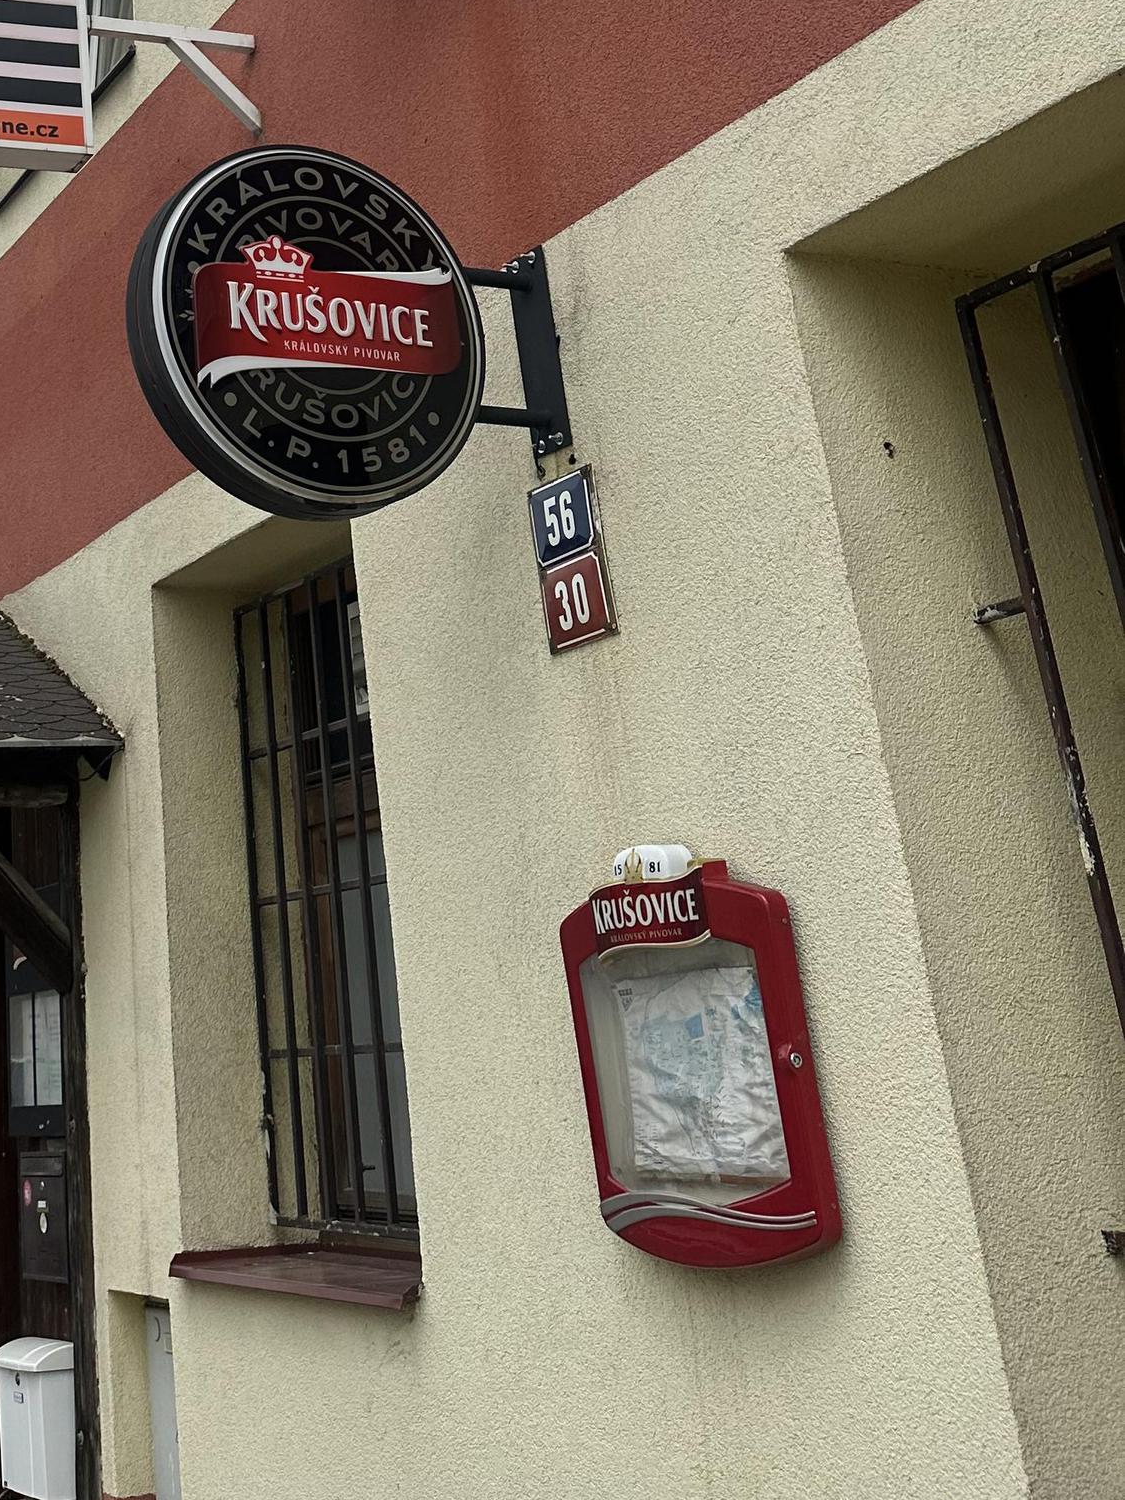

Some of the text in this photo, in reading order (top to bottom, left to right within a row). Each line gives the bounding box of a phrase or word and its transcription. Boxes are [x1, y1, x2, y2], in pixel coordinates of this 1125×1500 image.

[227, 281, 433, 348] KRUŠOVICE
[284, 340, 400, 362] KRÁLOVSKÝ PIVOVAR
[249, 368, 415, 428] RUŠOVIC
[337, 424, 427, 474] 1581
[543, 490, 576, 547] 56
[554, 573, 590, 631] 30
[592, 889, 699, 934] KRUŠOVICE
[649, 928, 683, 938] PIVOVAR
